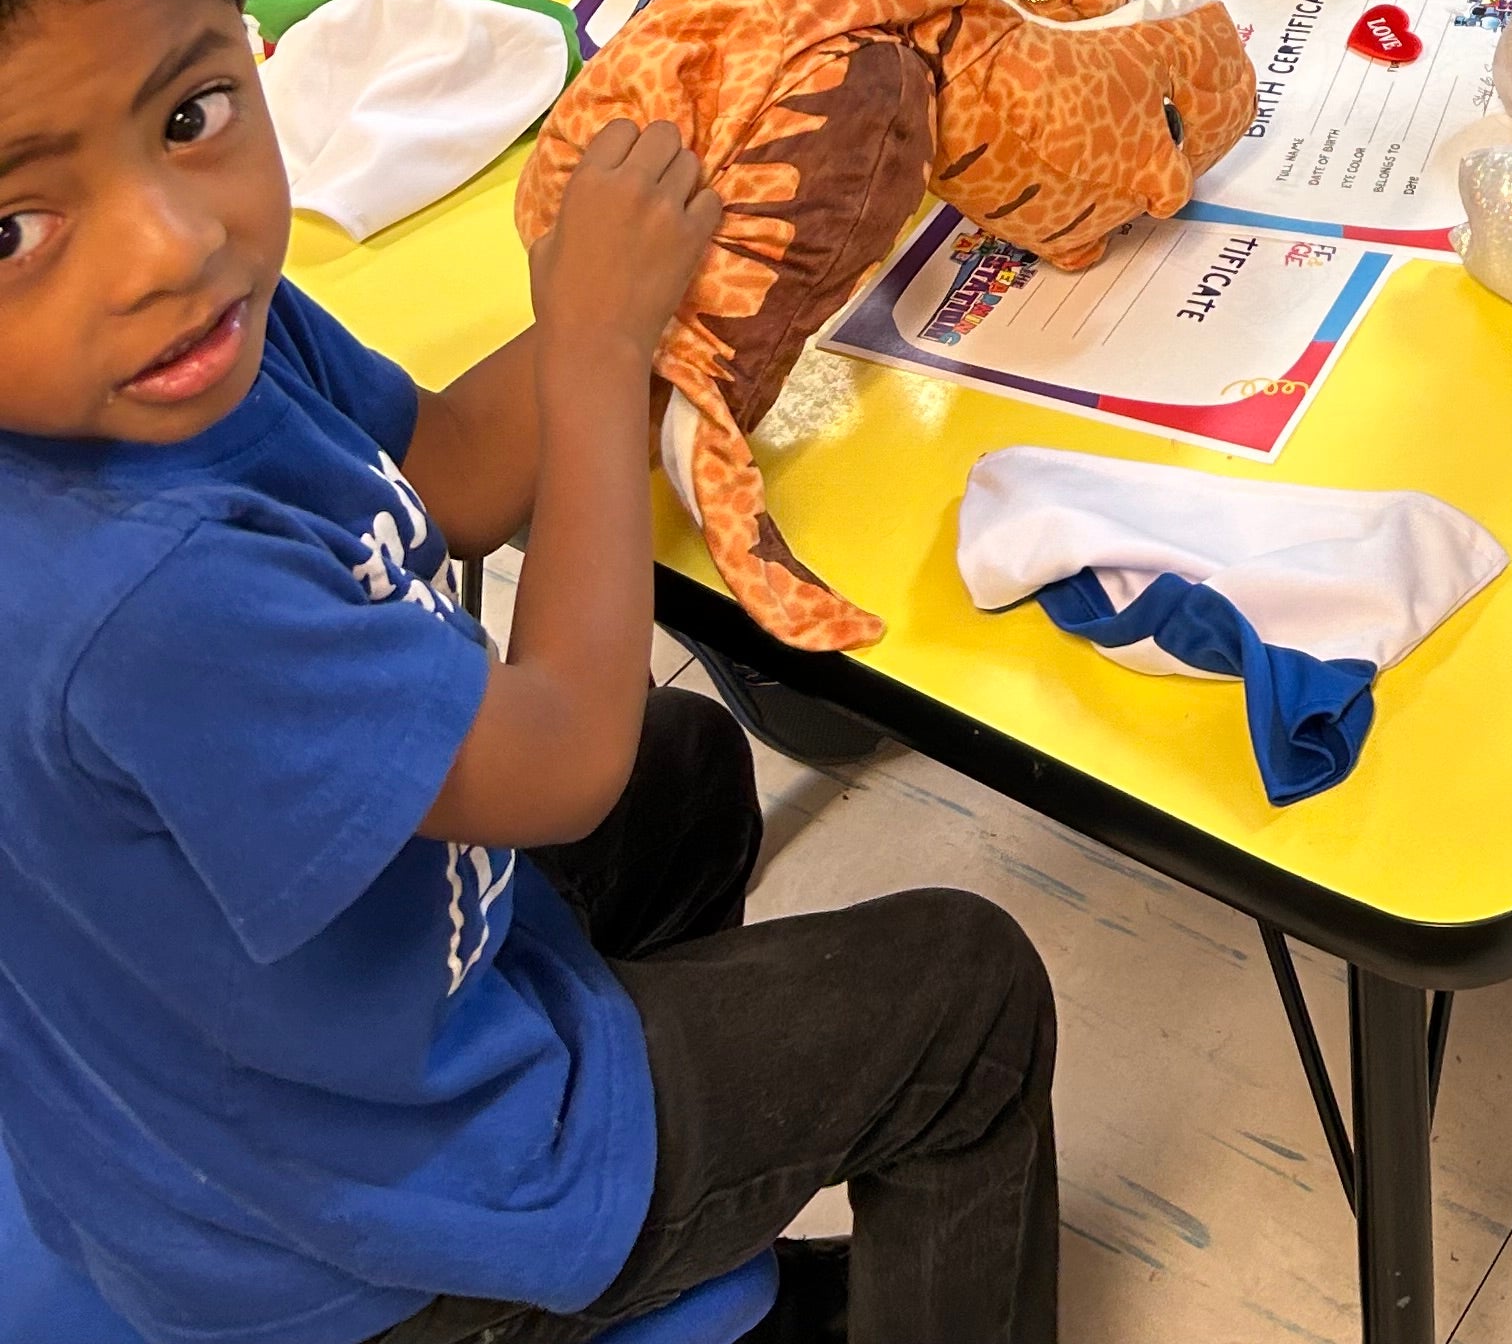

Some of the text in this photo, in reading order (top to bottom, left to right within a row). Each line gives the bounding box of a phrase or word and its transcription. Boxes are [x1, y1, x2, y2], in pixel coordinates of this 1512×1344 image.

[1367, 16, 1402, 51] LOVE
[1245, 80, 1286, 138] BIRTH
[1276, 137, 1305, 183] FULL NAME
[1308, 128, 1341, 186] DATE OF BIRTH
[1341, 147, 1366, 189] EYE COLOR
[1373, 143, 1401, 193] BELONGS TO
[1403, 175, 1420, 195] Date
[1012, 267, 1038, 290] THE
